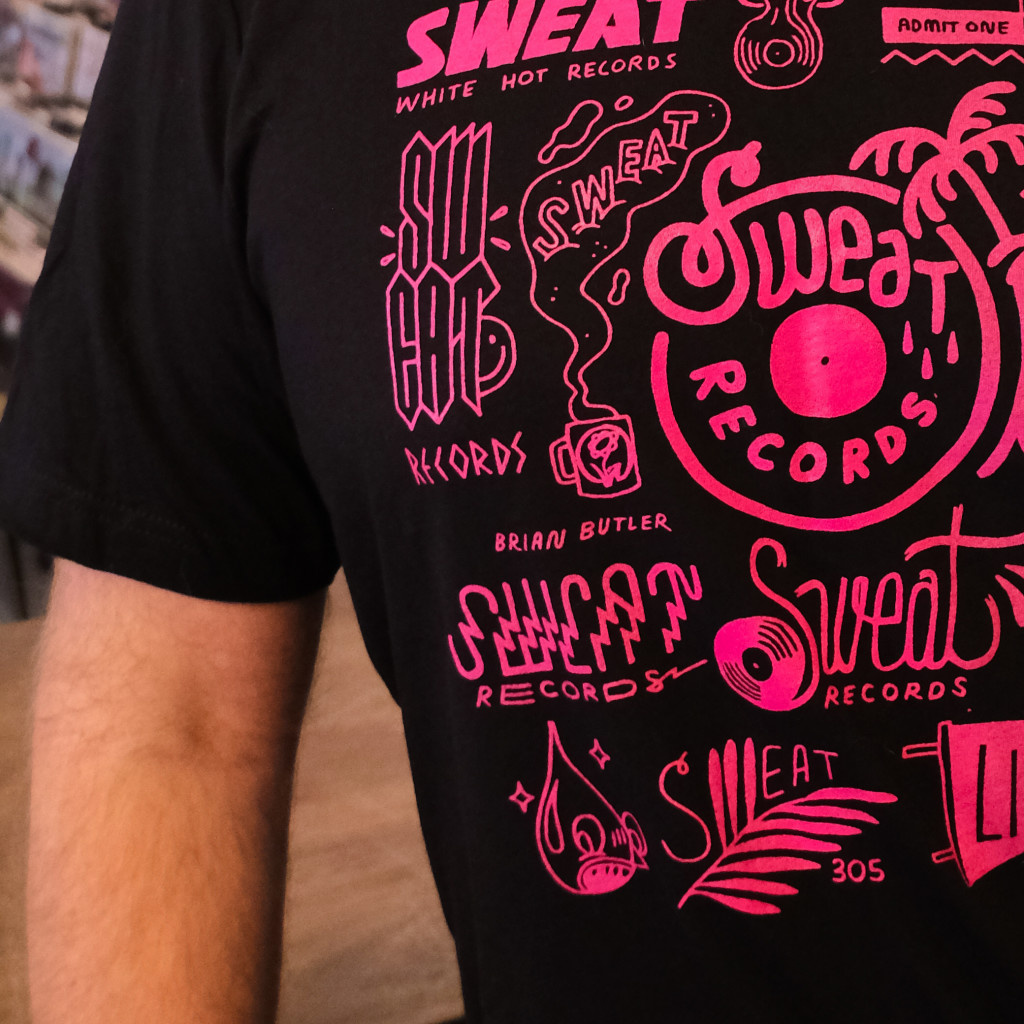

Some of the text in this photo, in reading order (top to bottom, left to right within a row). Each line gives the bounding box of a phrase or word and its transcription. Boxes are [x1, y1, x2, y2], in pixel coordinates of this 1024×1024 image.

[897, 17, 1010, 36] ADMIT ONE
[396, 53, 677, 114] WHITE HOT RECORDS
[533, 110, 698, 262] SWEAT
[689, 360, 938, 484] RECORDS
[405, 431, 527, 486] RECORDS
[495, 513, 672, 553] BRIAN BUTLER
[448, 562, 702, 680] SWEAT
[476, 668, 668, 708] RECORDS
[824, 676, 968, 709] RECORDS
[832, 858, 885, 883] 305
